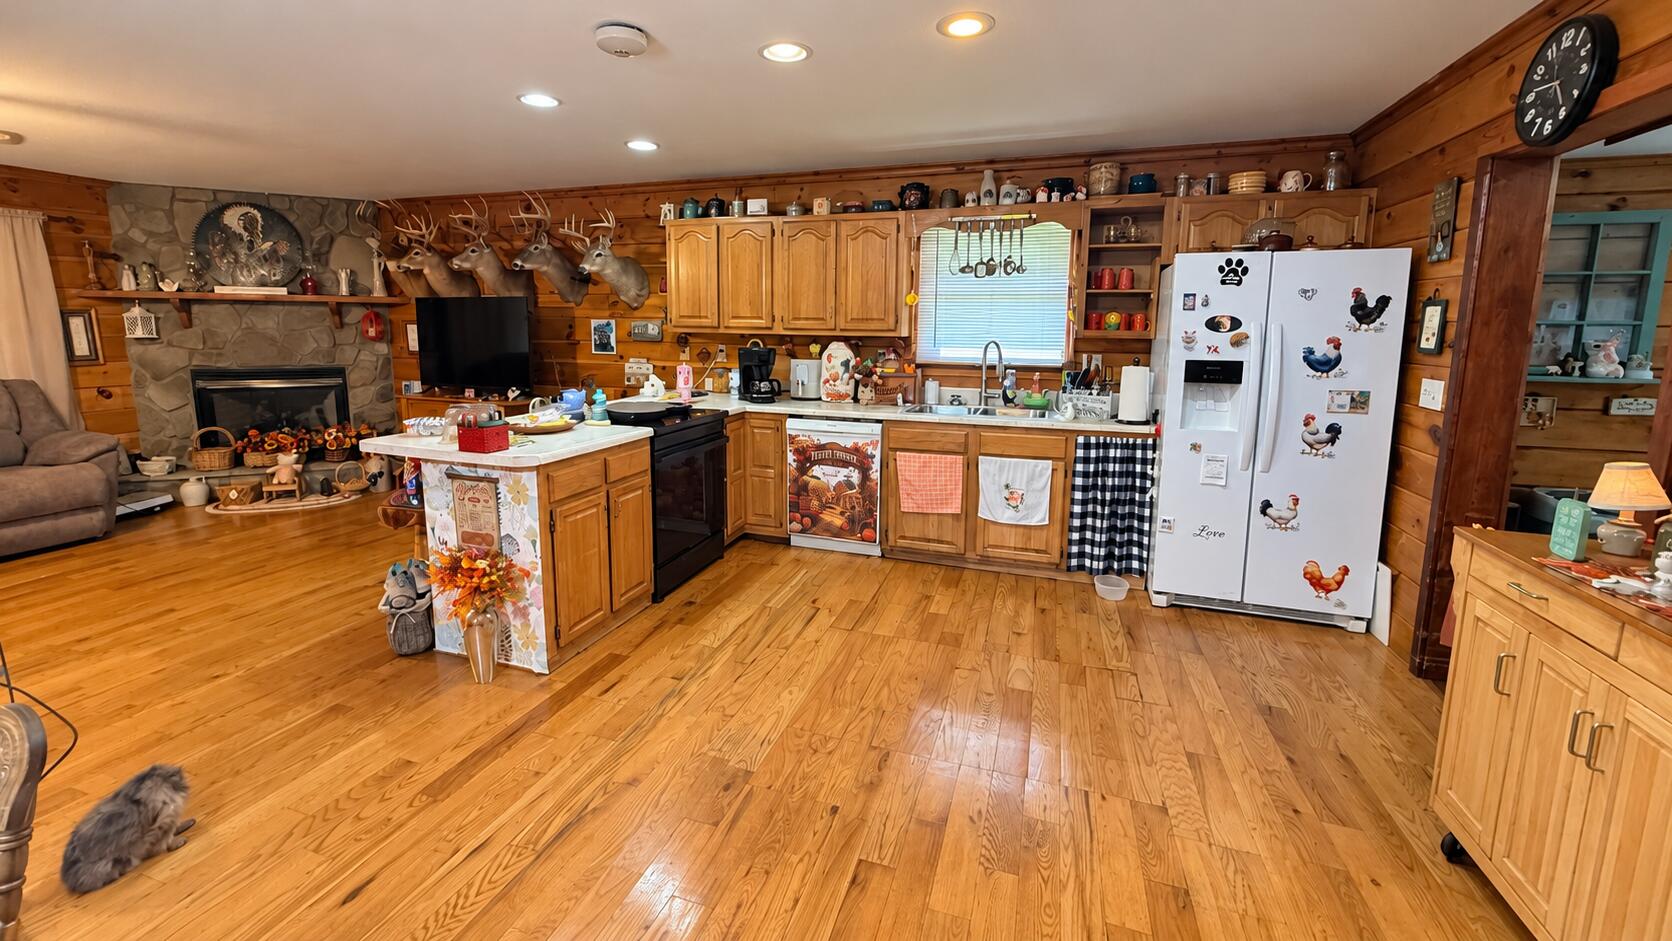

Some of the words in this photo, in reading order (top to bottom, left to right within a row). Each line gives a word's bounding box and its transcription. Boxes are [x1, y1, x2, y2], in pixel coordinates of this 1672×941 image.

[1560, 28, 1575, 50] 12
[1575, 26, 1587, 46] 1
[1546, 42, 1557, 61] 11
[1533, 65, 1545, 81] 10
[1523, 109, 1535, 123] 8
[1558, 106, 1567, 120] 5
[1530, 117, 1542, 137] 7
[1543, 119, 1552, 136] 6
[1192, 524, 1226, 541] Love
